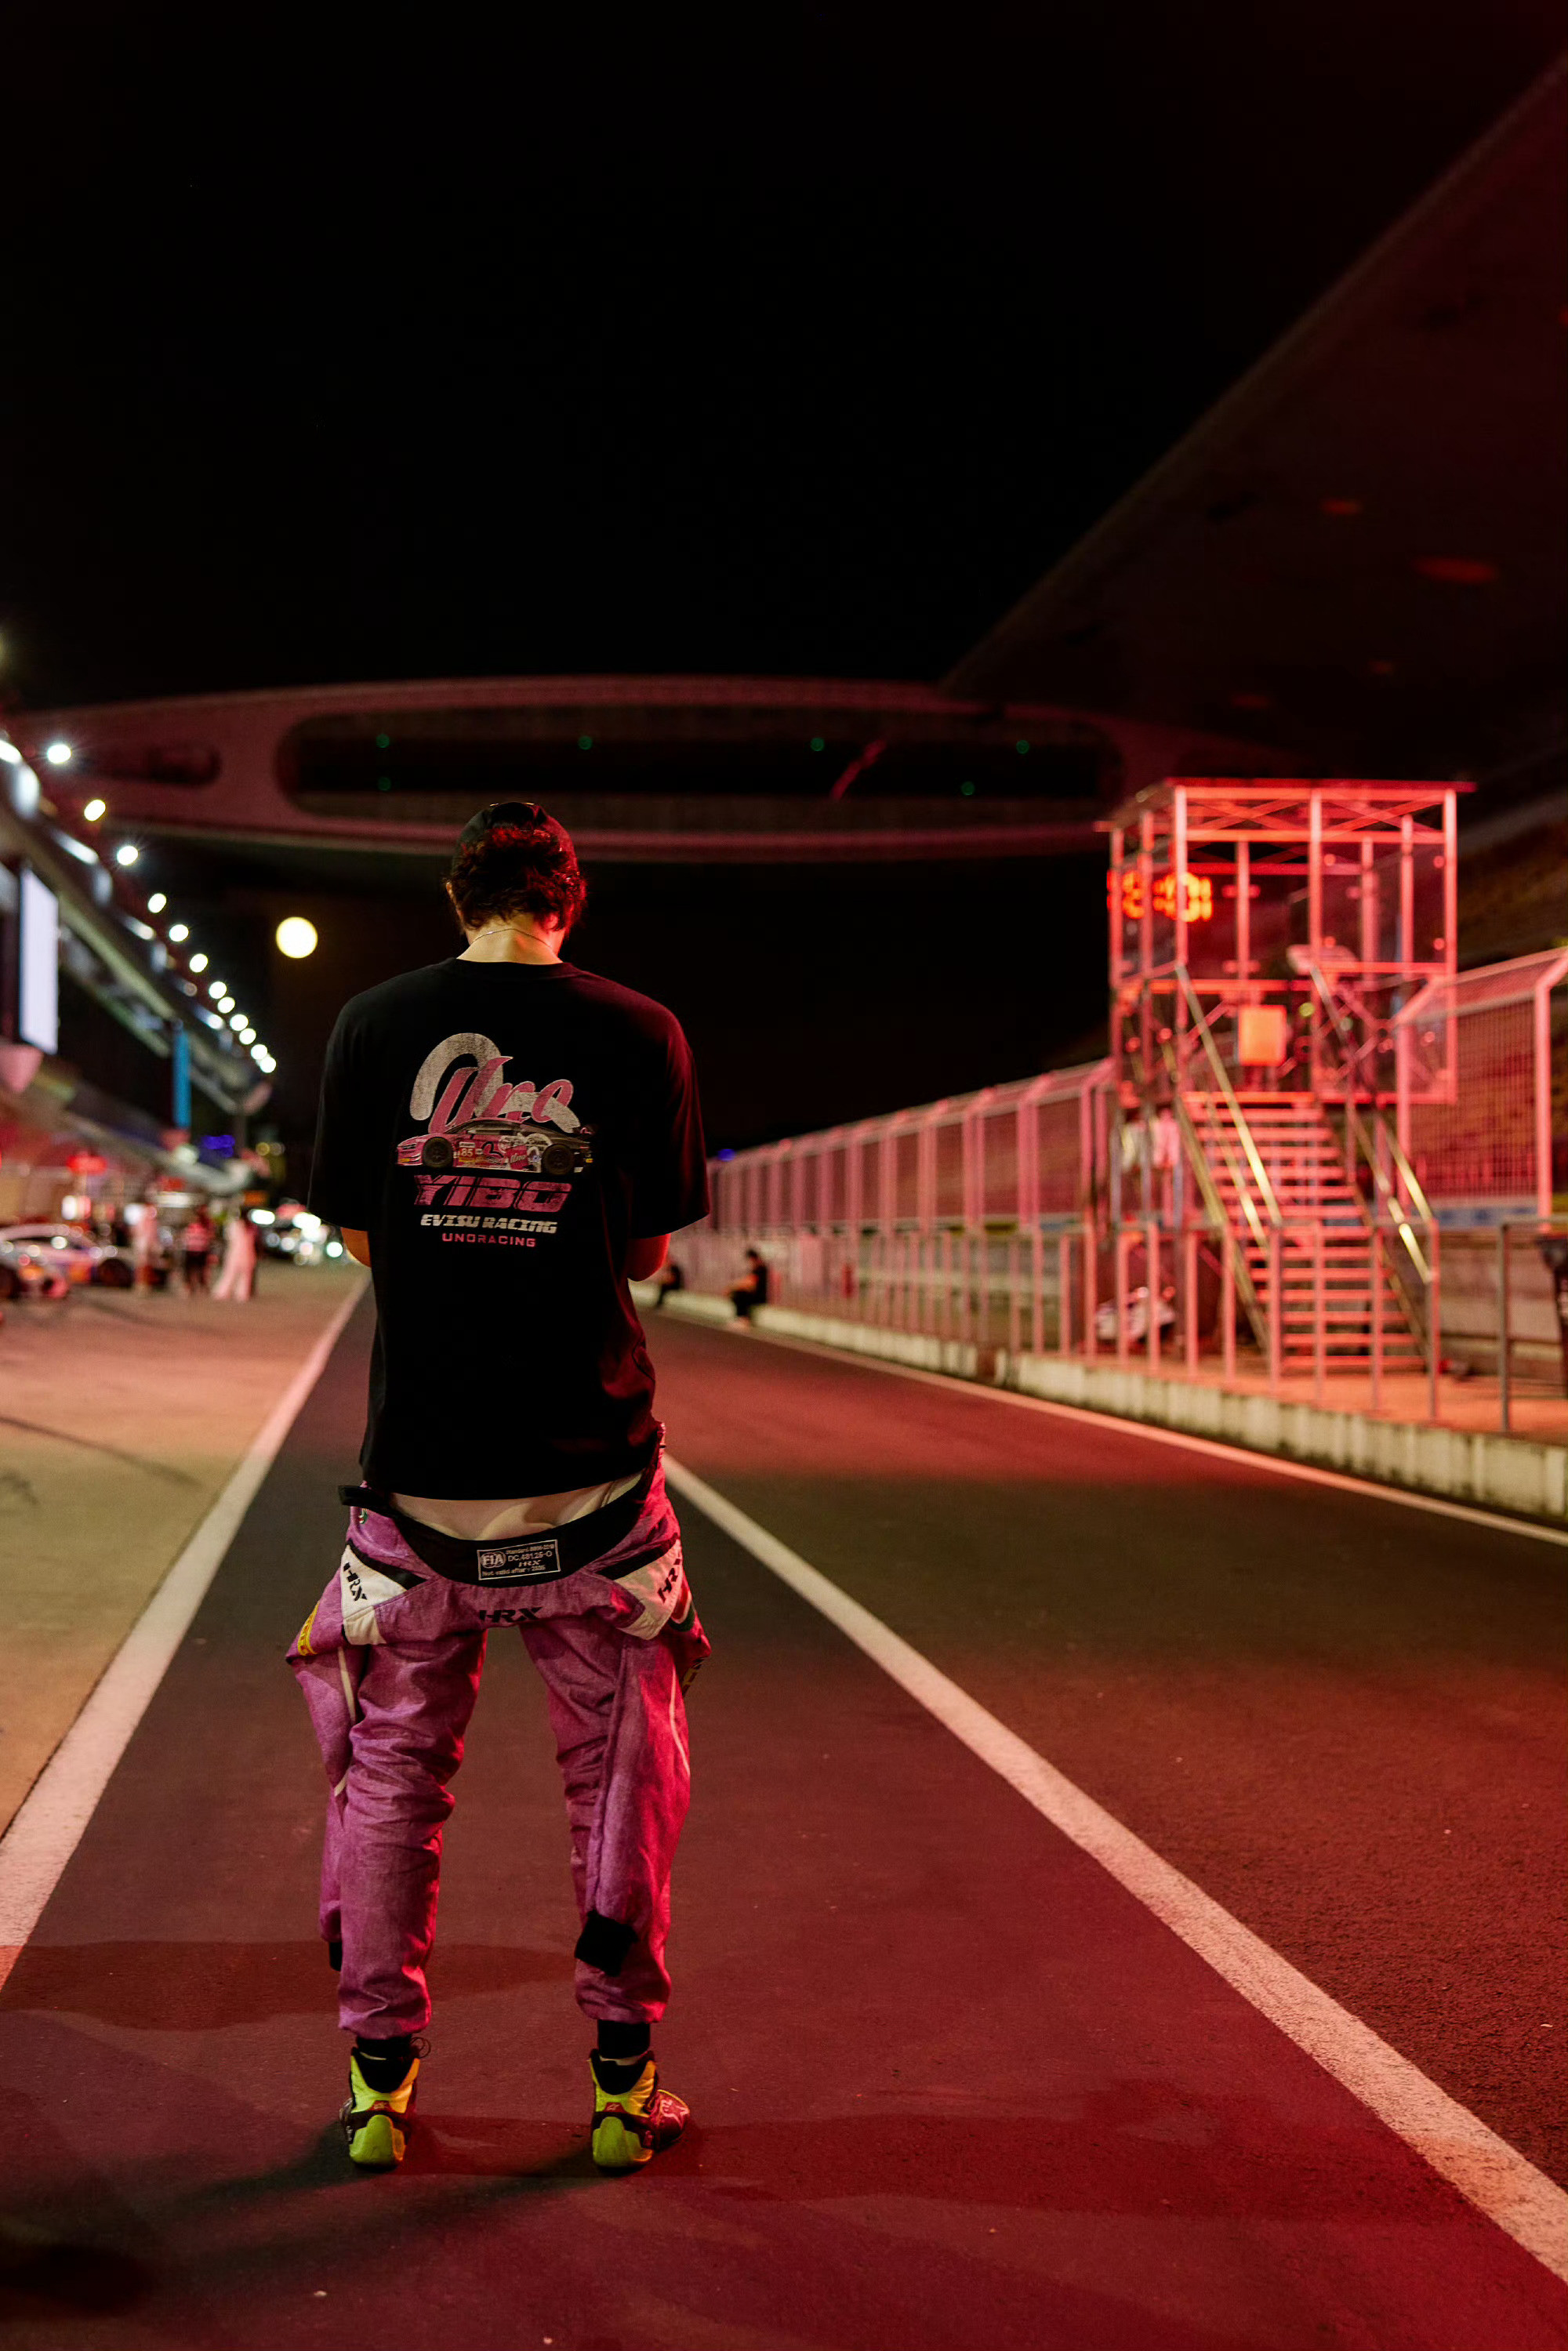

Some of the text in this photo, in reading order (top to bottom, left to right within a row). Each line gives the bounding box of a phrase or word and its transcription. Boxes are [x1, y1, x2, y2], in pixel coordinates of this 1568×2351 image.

[461, 1148, 474, 1157] 85
[420, 1214, 559, 1235] EVISU RACING
[441, 1232, 536, 1247] UNORACING
[481, 1552, 505, 1566] FIA
[343, 1562, 368, 1601] HRX
[480, 1607, 543, 1623] HRX
